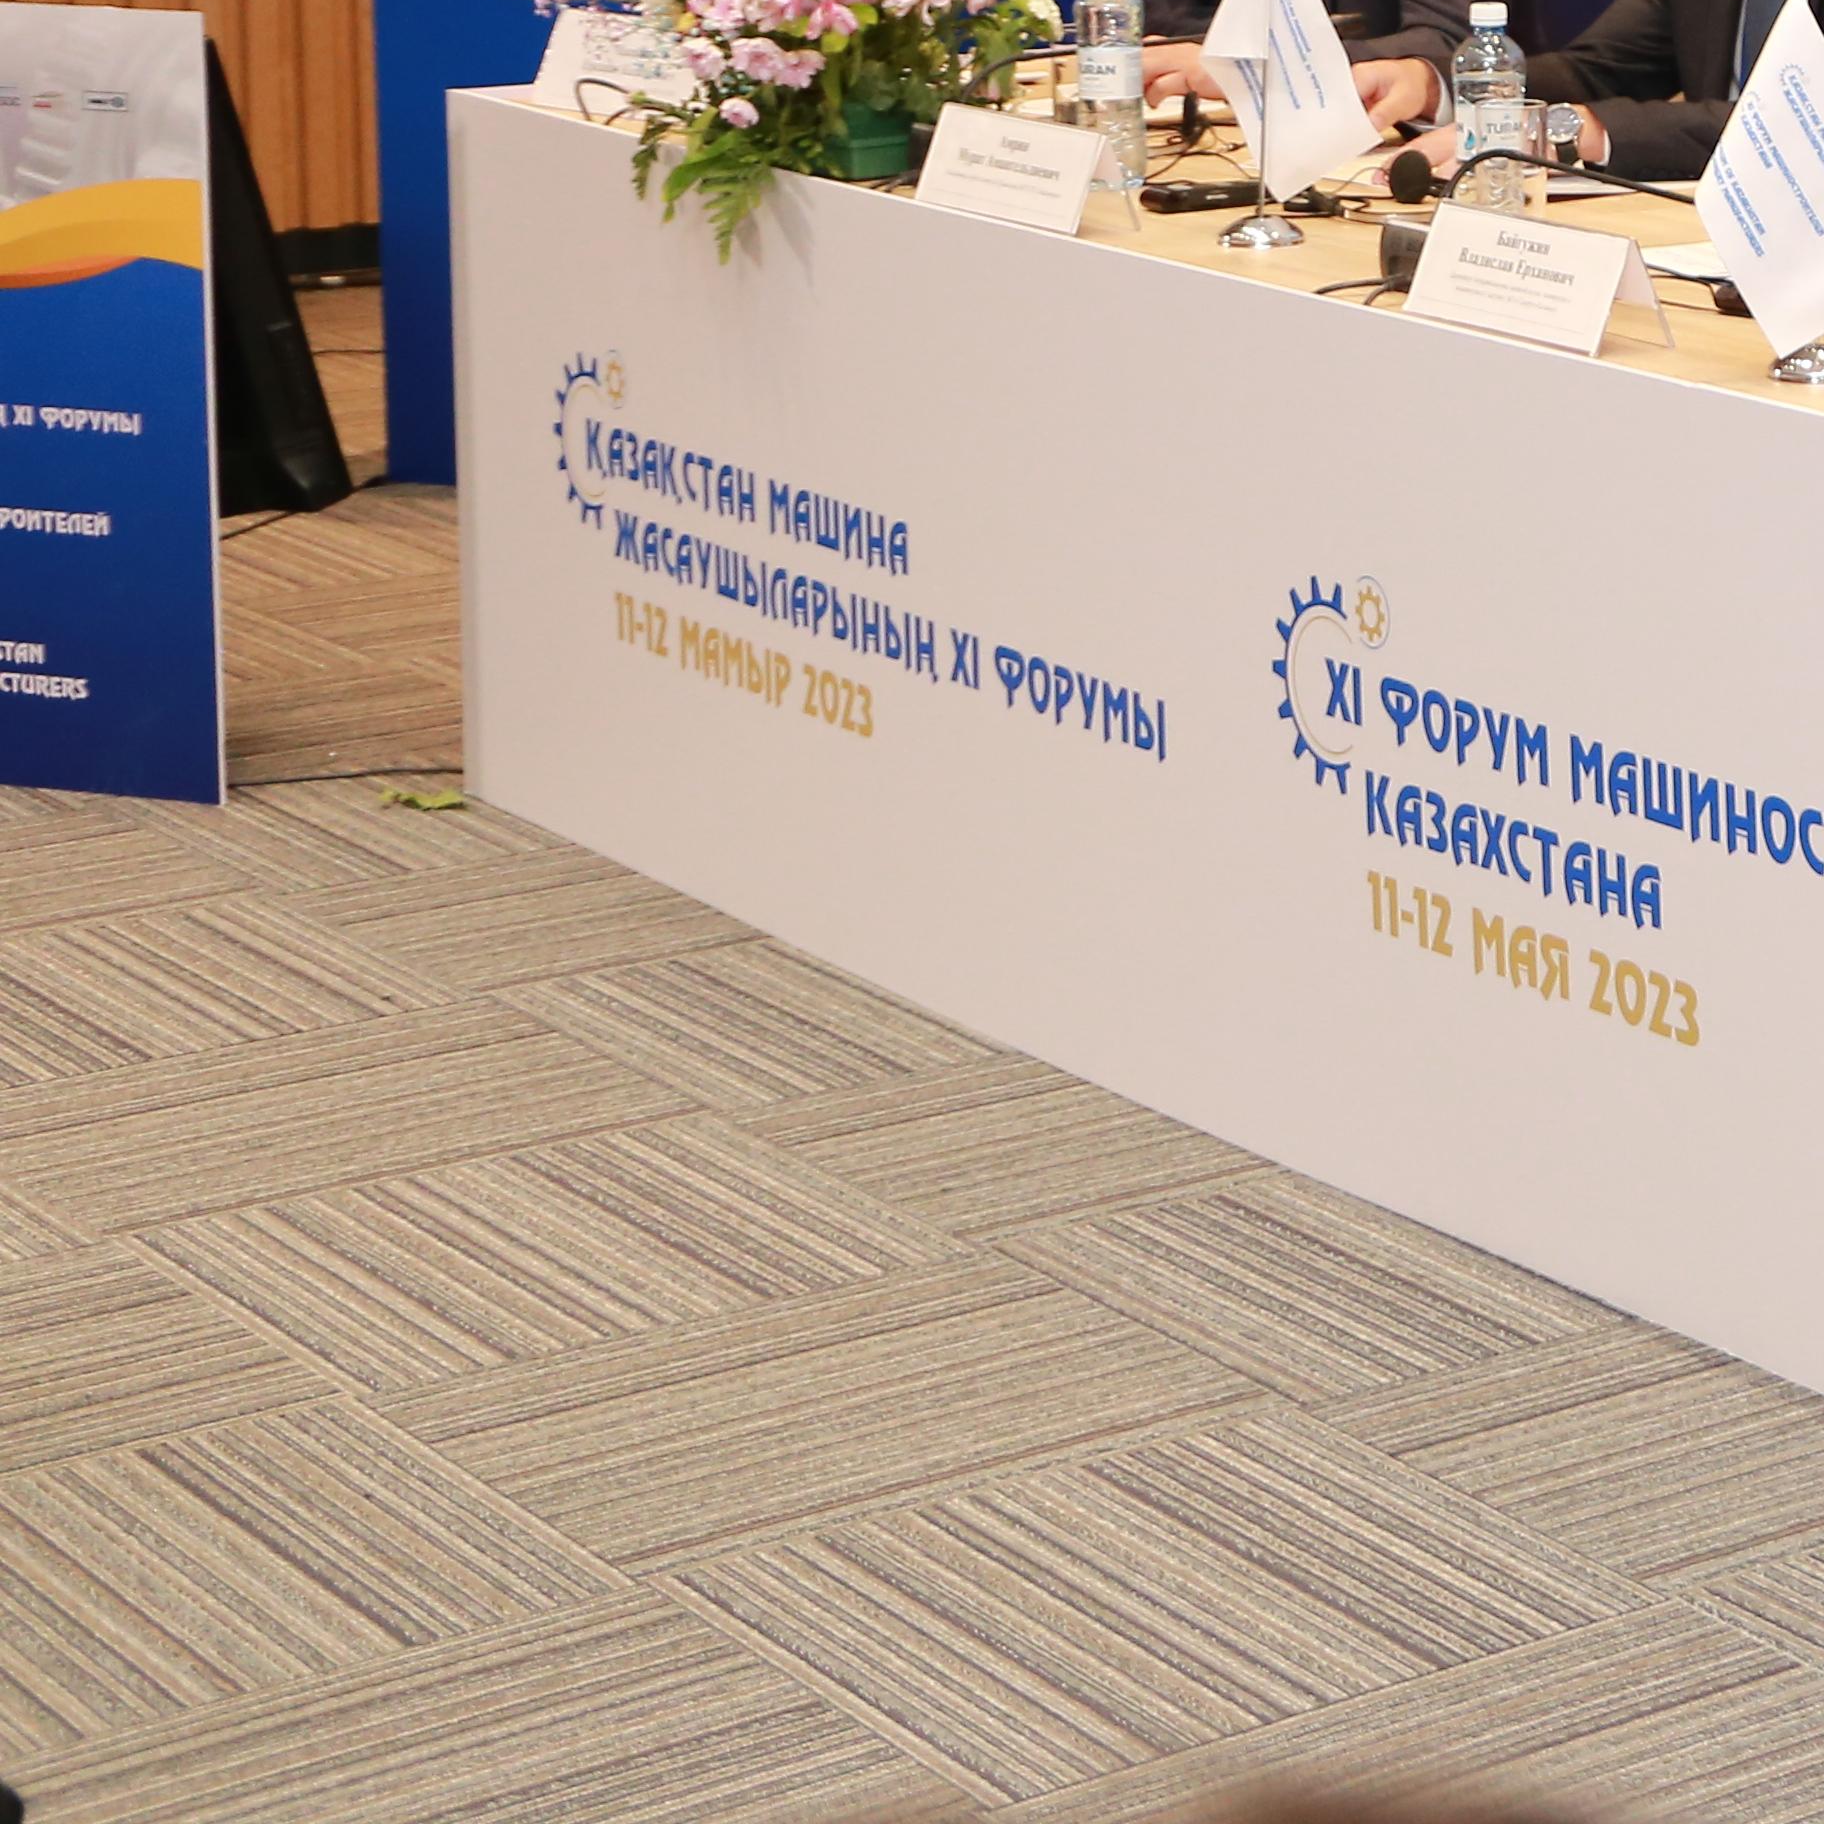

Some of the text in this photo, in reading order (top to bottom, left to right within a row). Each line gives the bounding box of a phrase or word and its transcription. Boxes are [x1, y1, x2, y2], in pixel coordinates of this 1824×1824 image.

[39, 405, 142, 436] ФОРУМЫ
[585, 418, 908, 575] ҚАЗАҚСТАН МАШИНА
[614, 508, 938, 683] ЖАСАУШЫЛАРЫНЫҢ
[994, 645, 1165, 762] ФОРУМЫ
[615, 592, 874, 738] 11-12 МАМЫР 2023
[1378, 676, 1549, 787] ФОРУМ
[1364, 769, 1662, 929] КАЗАХСТАНА
[1366, 870, 1701, 1048] 11-12 МАЯ 2023
